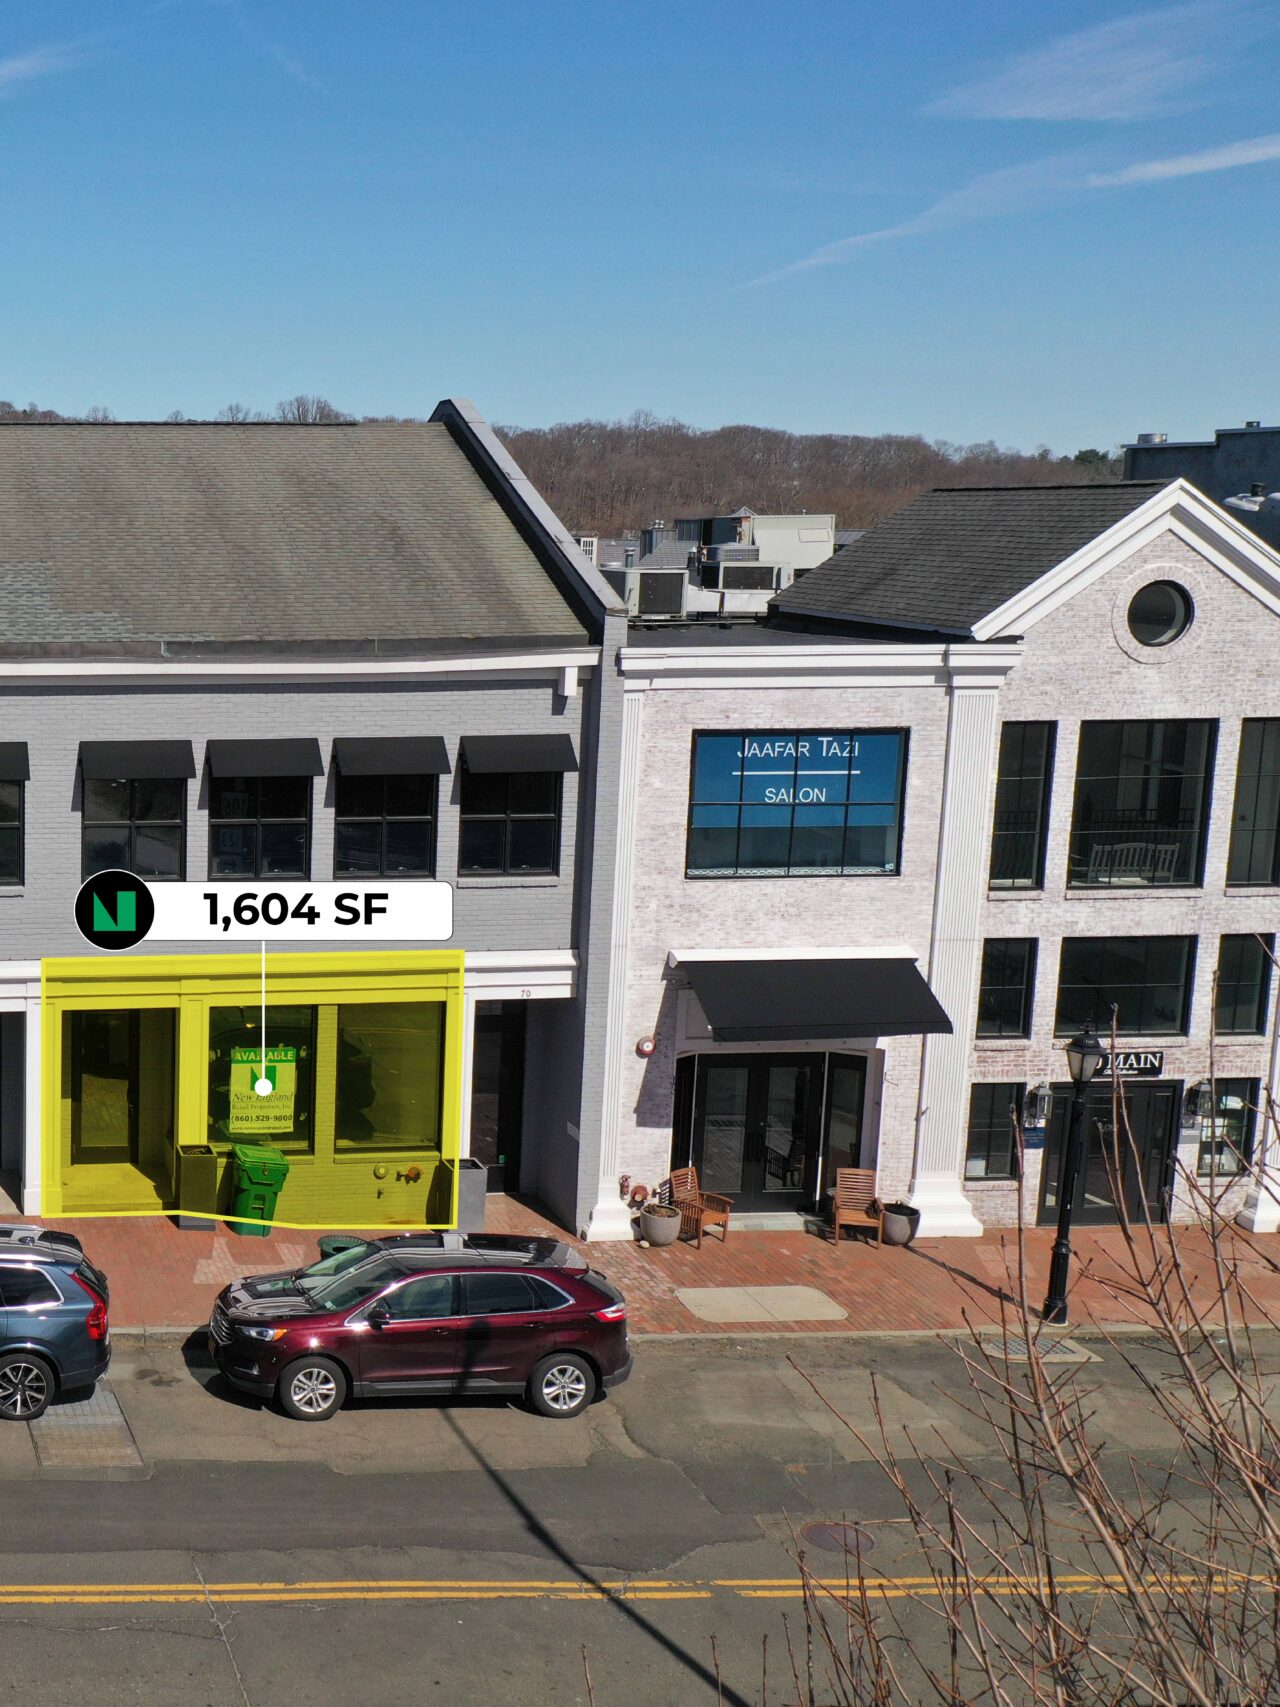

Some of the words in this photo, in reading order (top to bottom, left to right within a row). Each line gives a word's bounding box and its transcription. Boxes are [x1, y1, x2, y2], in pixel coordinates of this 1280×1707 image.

[737, 738, 810, 757] JAAFAR
[817, 737, 859, 757] TAZI
[764, 788, 826, 803] SALON
[234, 1051, 294, 1060] AVAIABLE
[1106, 1053, 1162, 1068] MAIN
[233, 1092, 253, 1101] New
[231, 1115, 253, 1123] (860)
